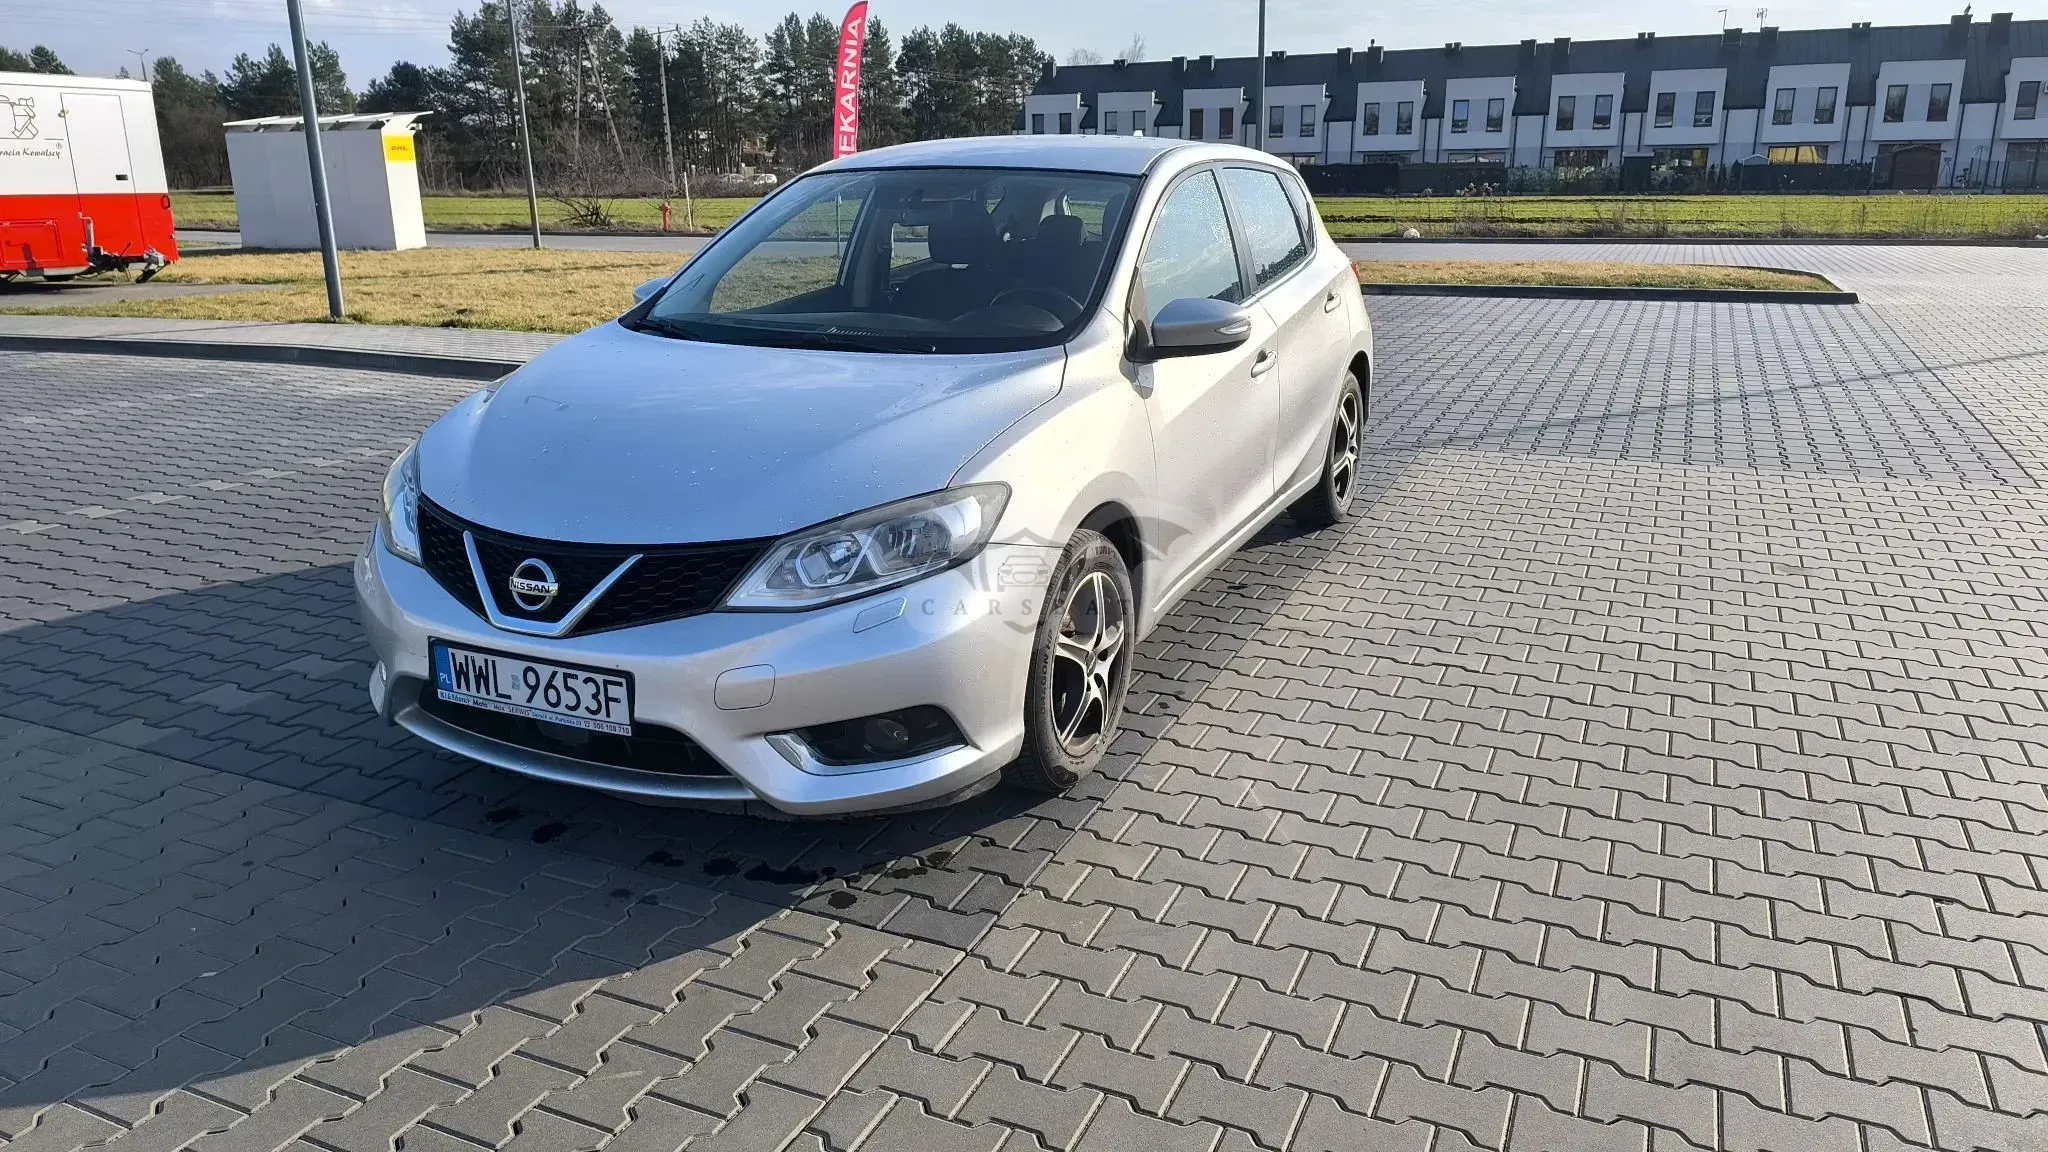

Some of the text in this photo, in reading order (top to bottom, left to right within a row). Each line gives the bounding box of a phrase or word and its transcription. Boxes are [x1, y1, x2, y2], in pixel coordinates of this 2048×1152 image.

[510, 577, 550, 594] NISSAN
[440, 673, 452, 684] PL
[451, 652, 624, 719] WWL 9653F
